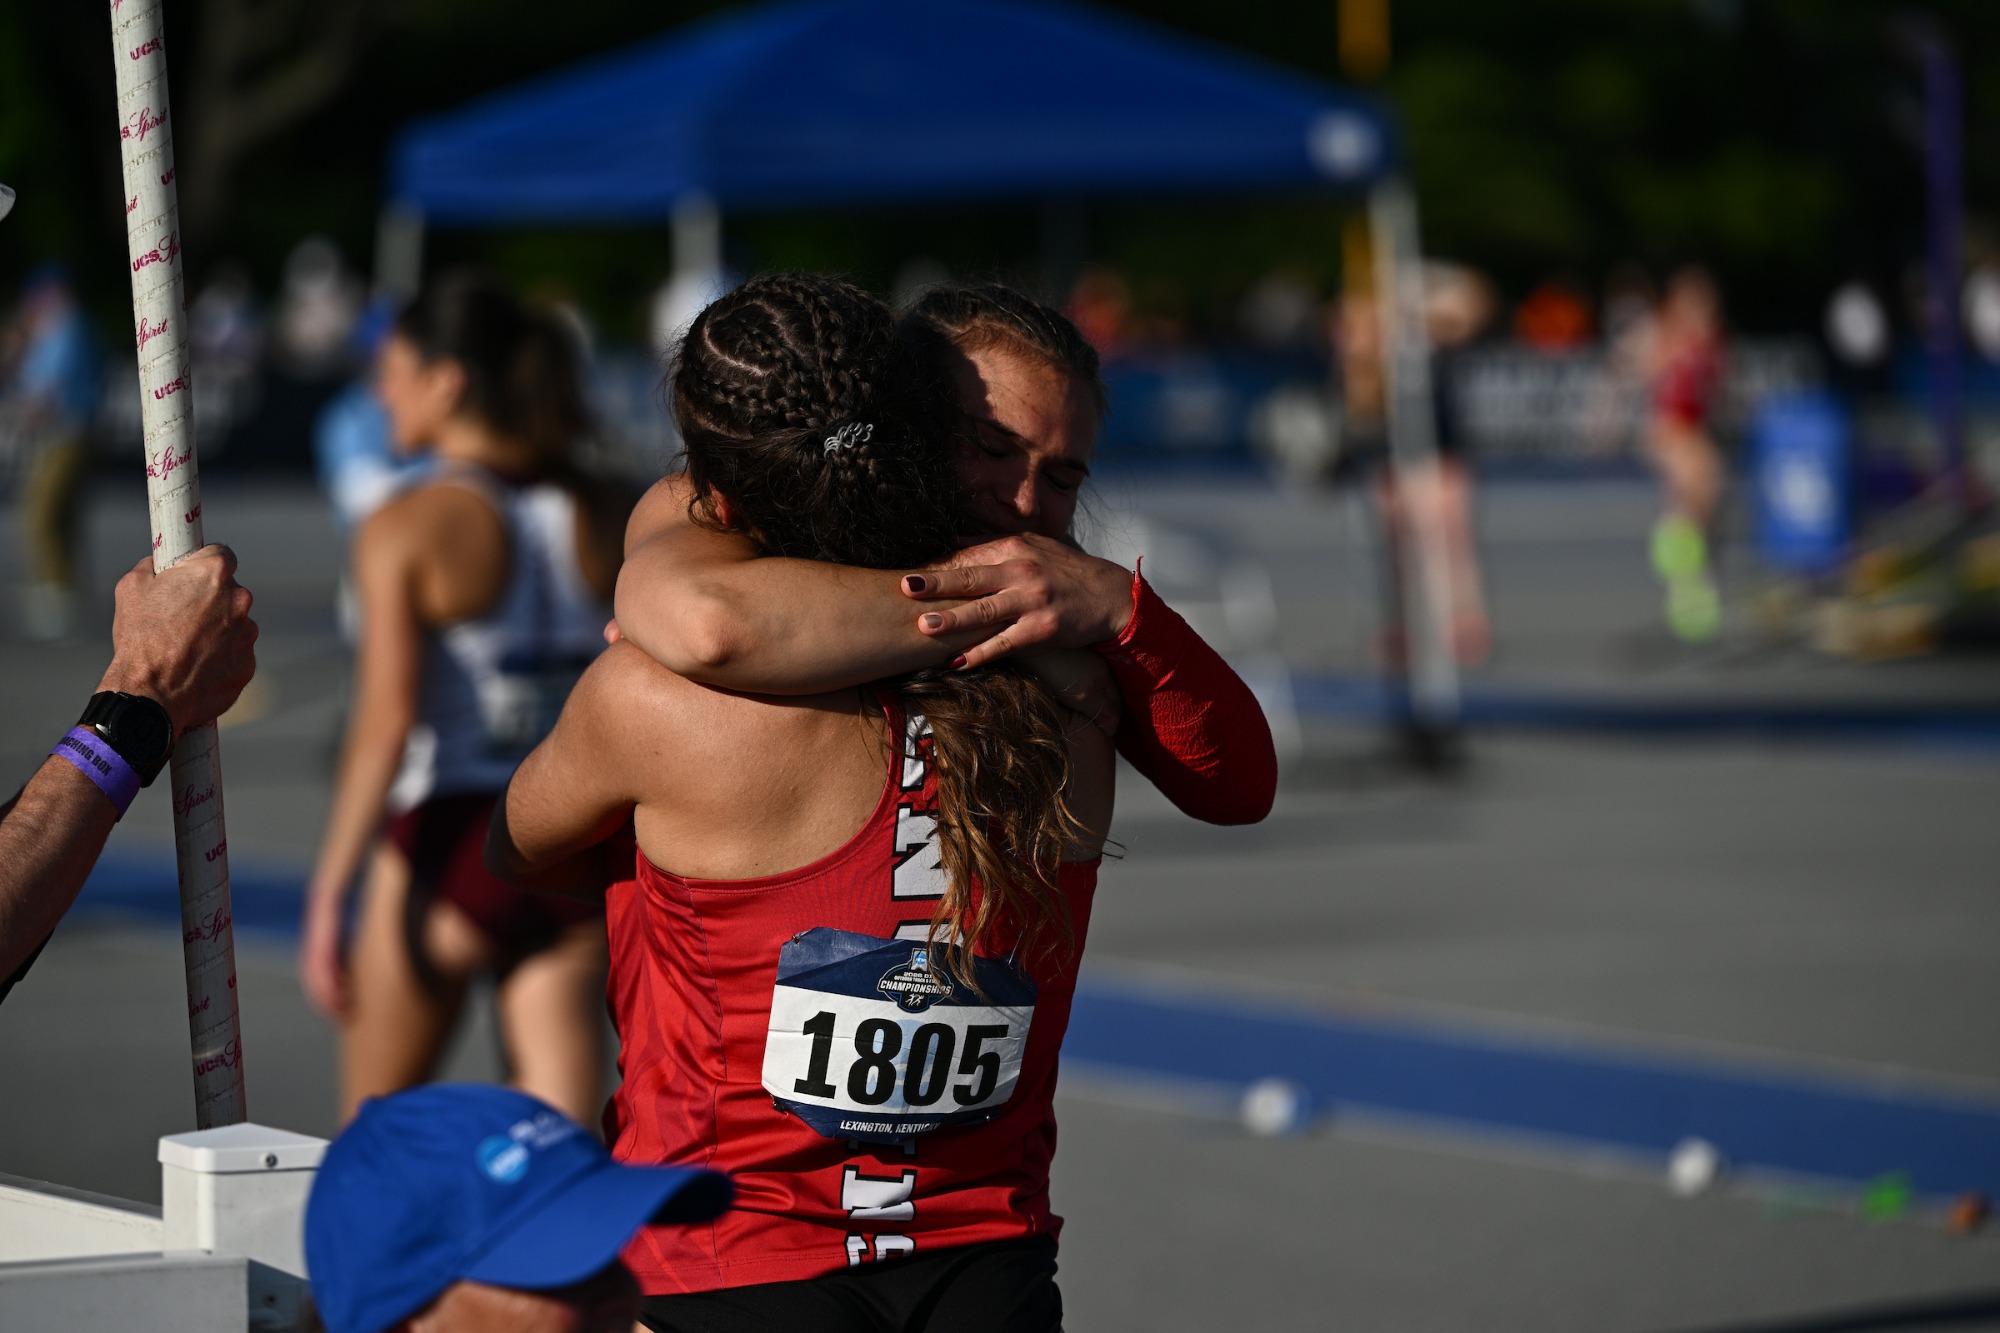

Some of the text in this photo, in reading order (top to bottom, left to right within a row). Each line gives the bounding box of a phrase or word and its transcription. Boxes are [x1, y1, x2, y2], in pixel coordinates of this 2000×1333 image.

[130, 37, 160, 61] UCS
[133, 249, 160, 272] UCS
[154, 376, 184, 400] UCS
[153, 445, 193, 481] Spirit
[59, 737, 112, 776] CHING BOX
[202, 907, 232, 943] Spiri
[794, 1010, 1010, 1106] 1805
[839, 1119, 893, 1134] LEXINGTON,
